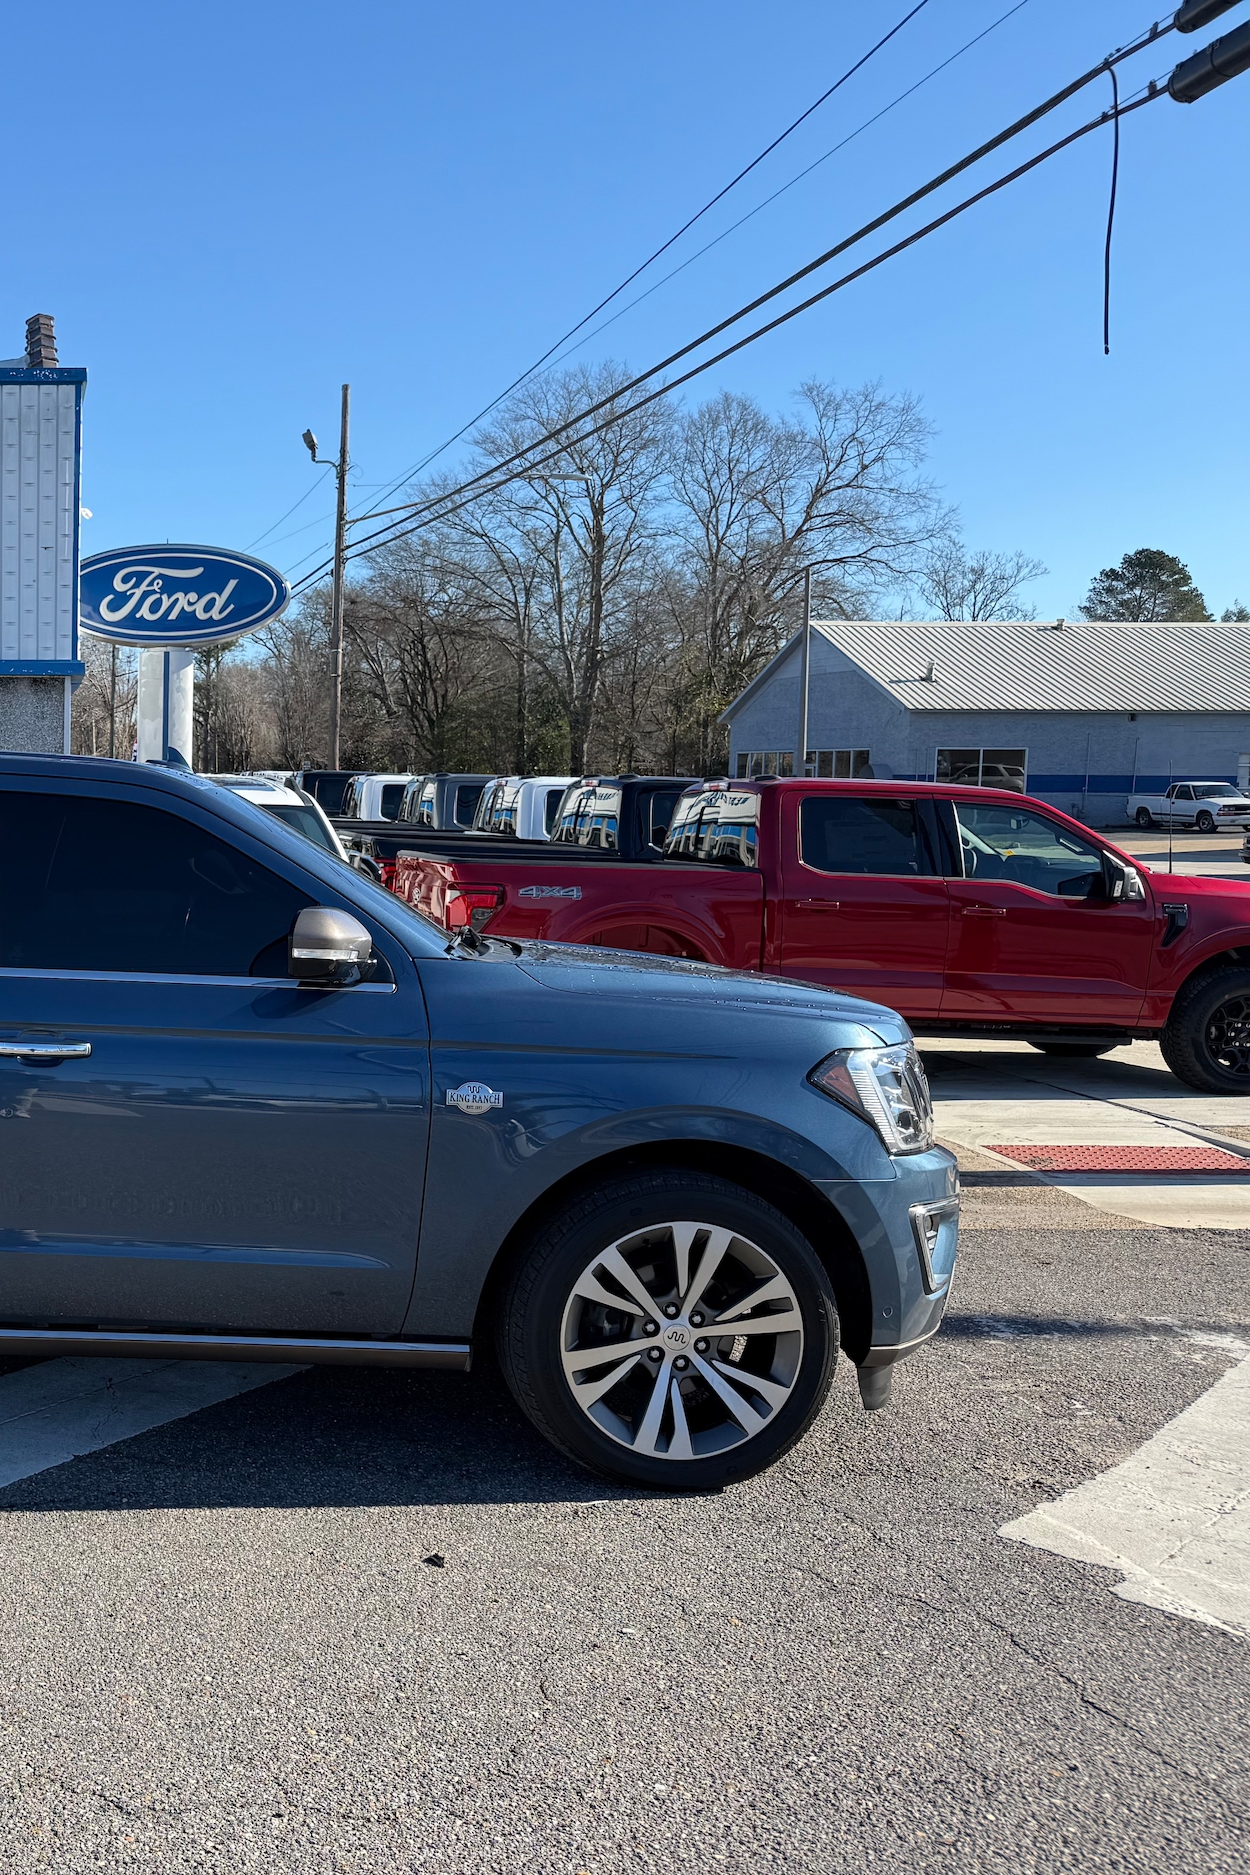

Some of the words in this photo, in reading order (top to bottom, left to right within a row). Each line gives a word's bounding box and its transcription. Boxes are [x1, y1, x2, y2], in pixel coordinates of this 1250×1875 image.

[99, 565, 239, 622] Ford
[450, 1092, 470, 1102] KING
[472, 1094, 500, 1104] RANCH
